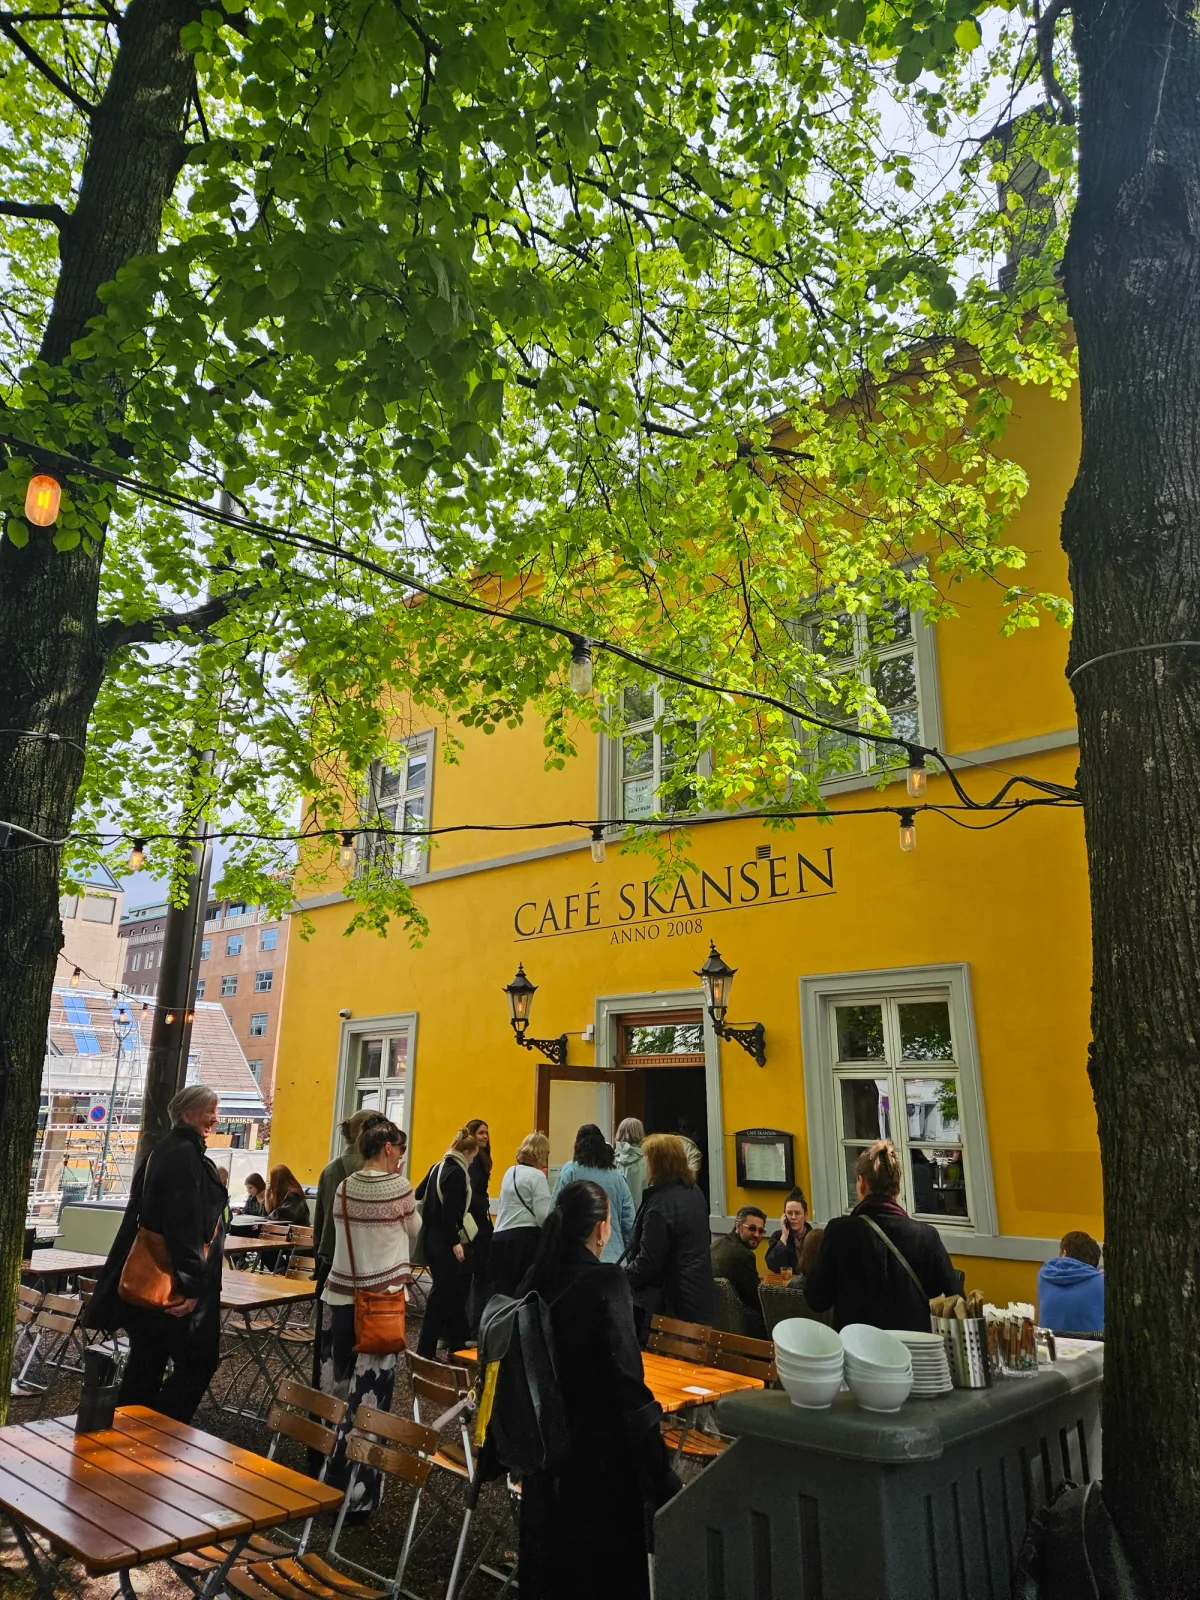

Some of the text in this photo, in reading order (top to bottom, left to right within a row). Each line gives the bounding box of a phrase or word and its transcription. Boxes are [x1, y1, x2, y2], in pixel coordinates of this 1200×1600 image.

[513, 846, 834, 937] CAFÉ SKANSEN
[610, 918, 703, 945] ANNO 2008
